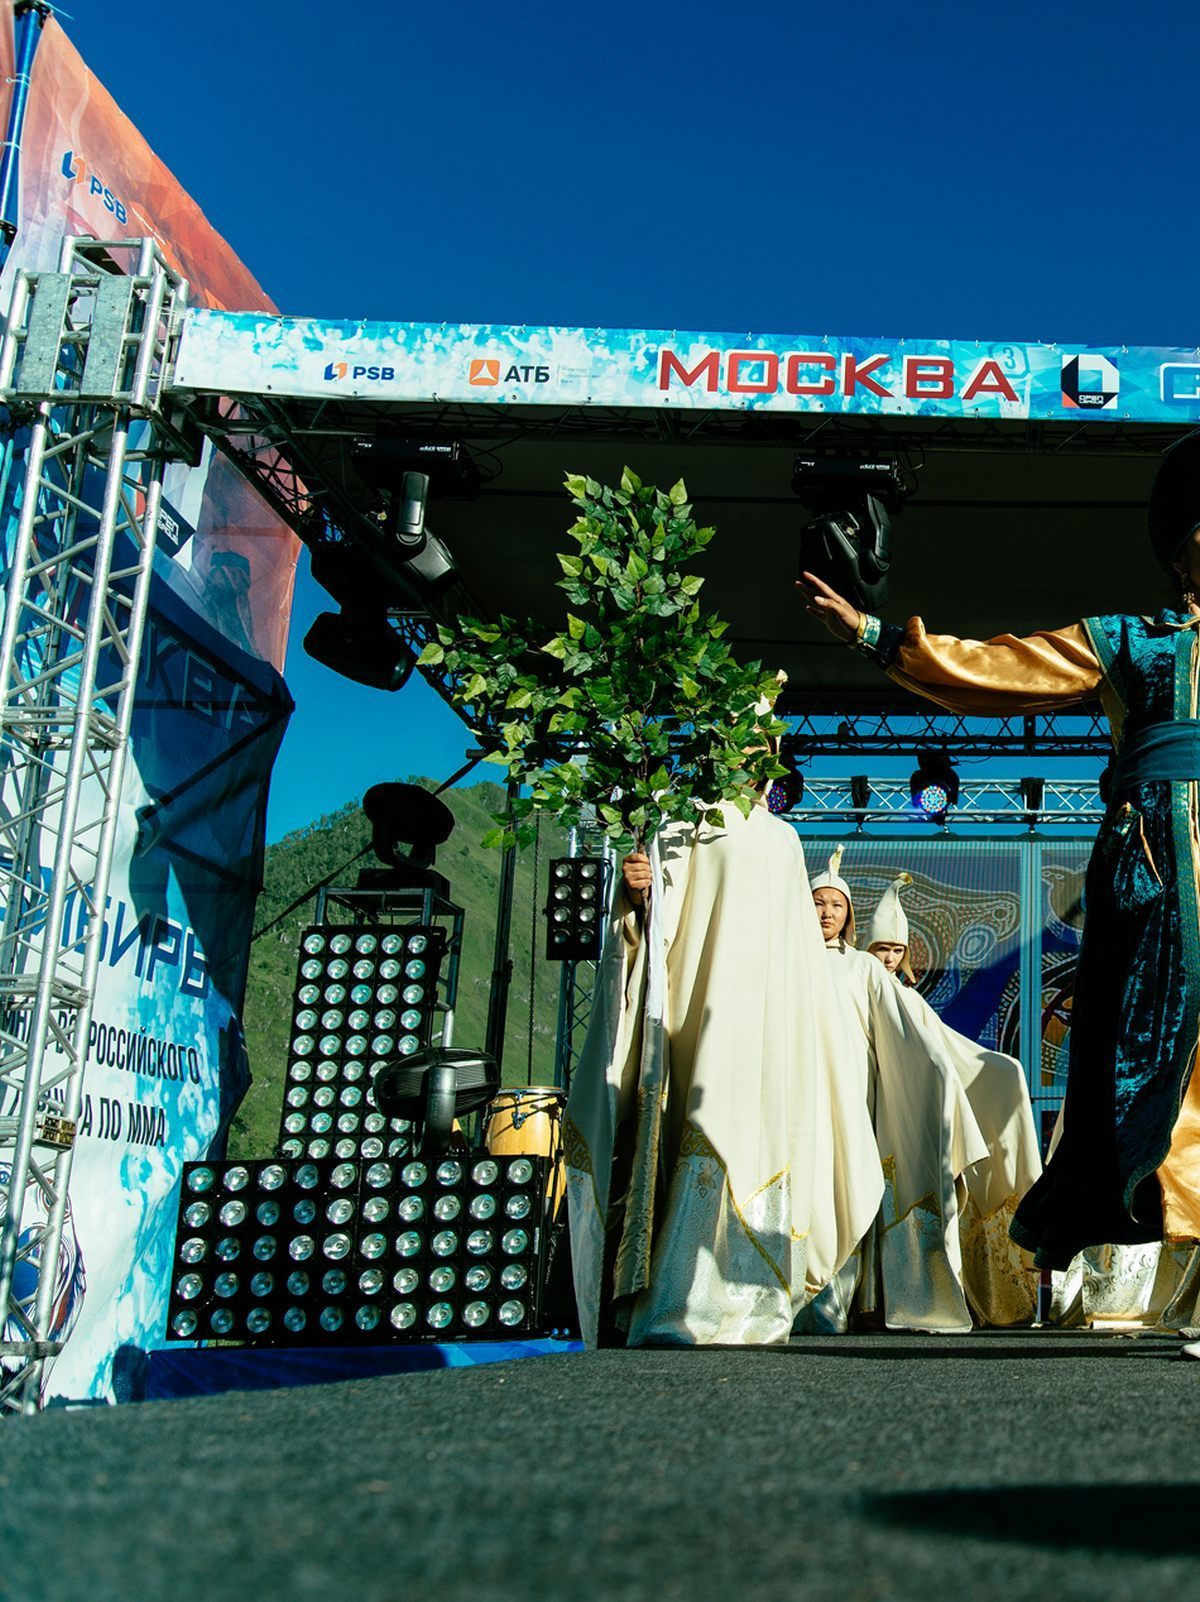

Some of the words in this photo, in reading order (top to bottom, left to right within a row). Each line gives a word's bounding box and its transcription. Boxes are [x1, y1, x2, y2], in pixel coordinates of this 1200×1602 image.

[89, 173, 128, 226] PSB
[352, 365, 396, 381] PSB
[503, 365, 550, 383] АТБ
[658, 350, 1020, 402] МОСКВА
[97, 1096, 122, 1141] ПО
[126, 1102, 166, 1147] ММА
